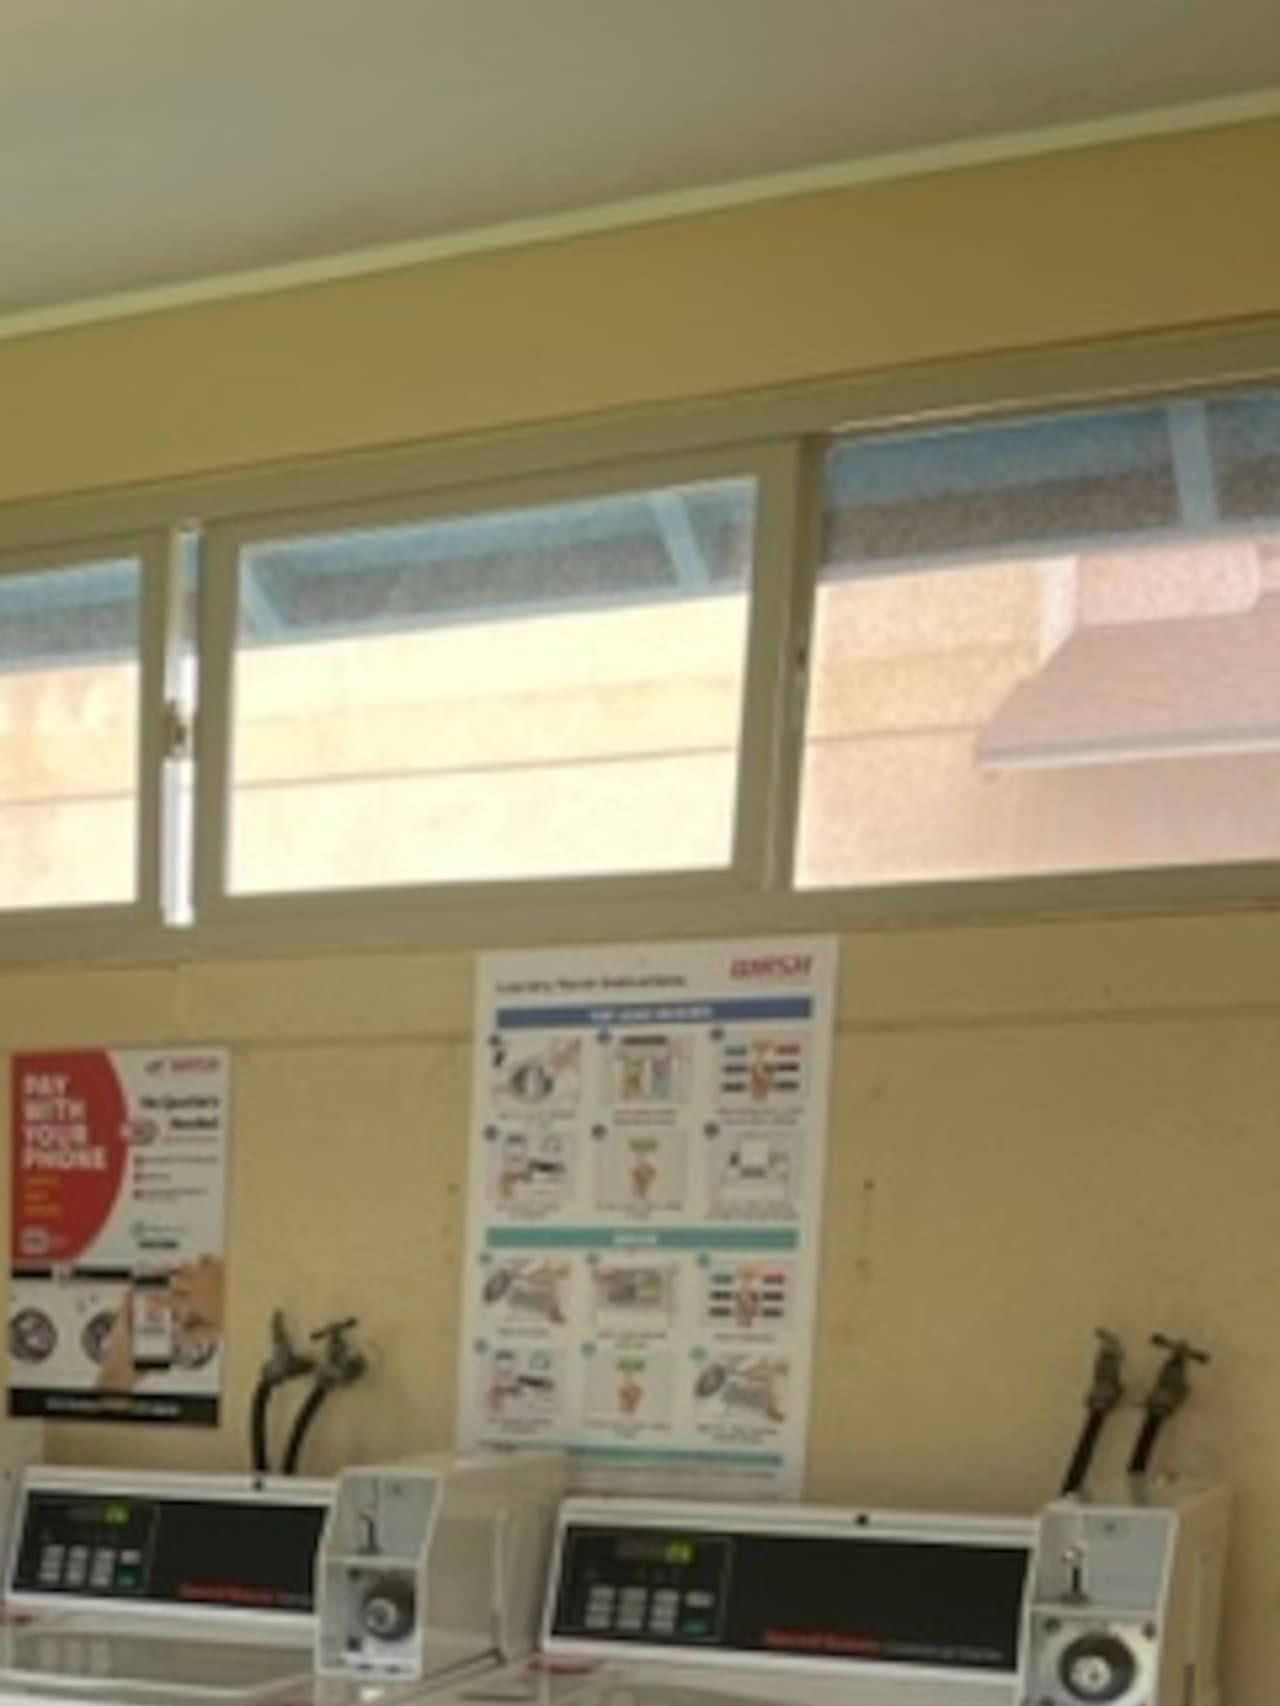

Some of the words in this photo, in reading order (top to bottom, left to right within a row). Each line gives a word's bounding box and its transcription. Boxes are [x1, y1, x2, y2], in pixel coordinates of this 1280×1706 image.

[23, 1074, 70, 1096] PAY
[23, 1098, 88, 1121] WITH
[22, 1123, 89, 1147] YOUR
[23, 1146, 108, 1171] PHONE
